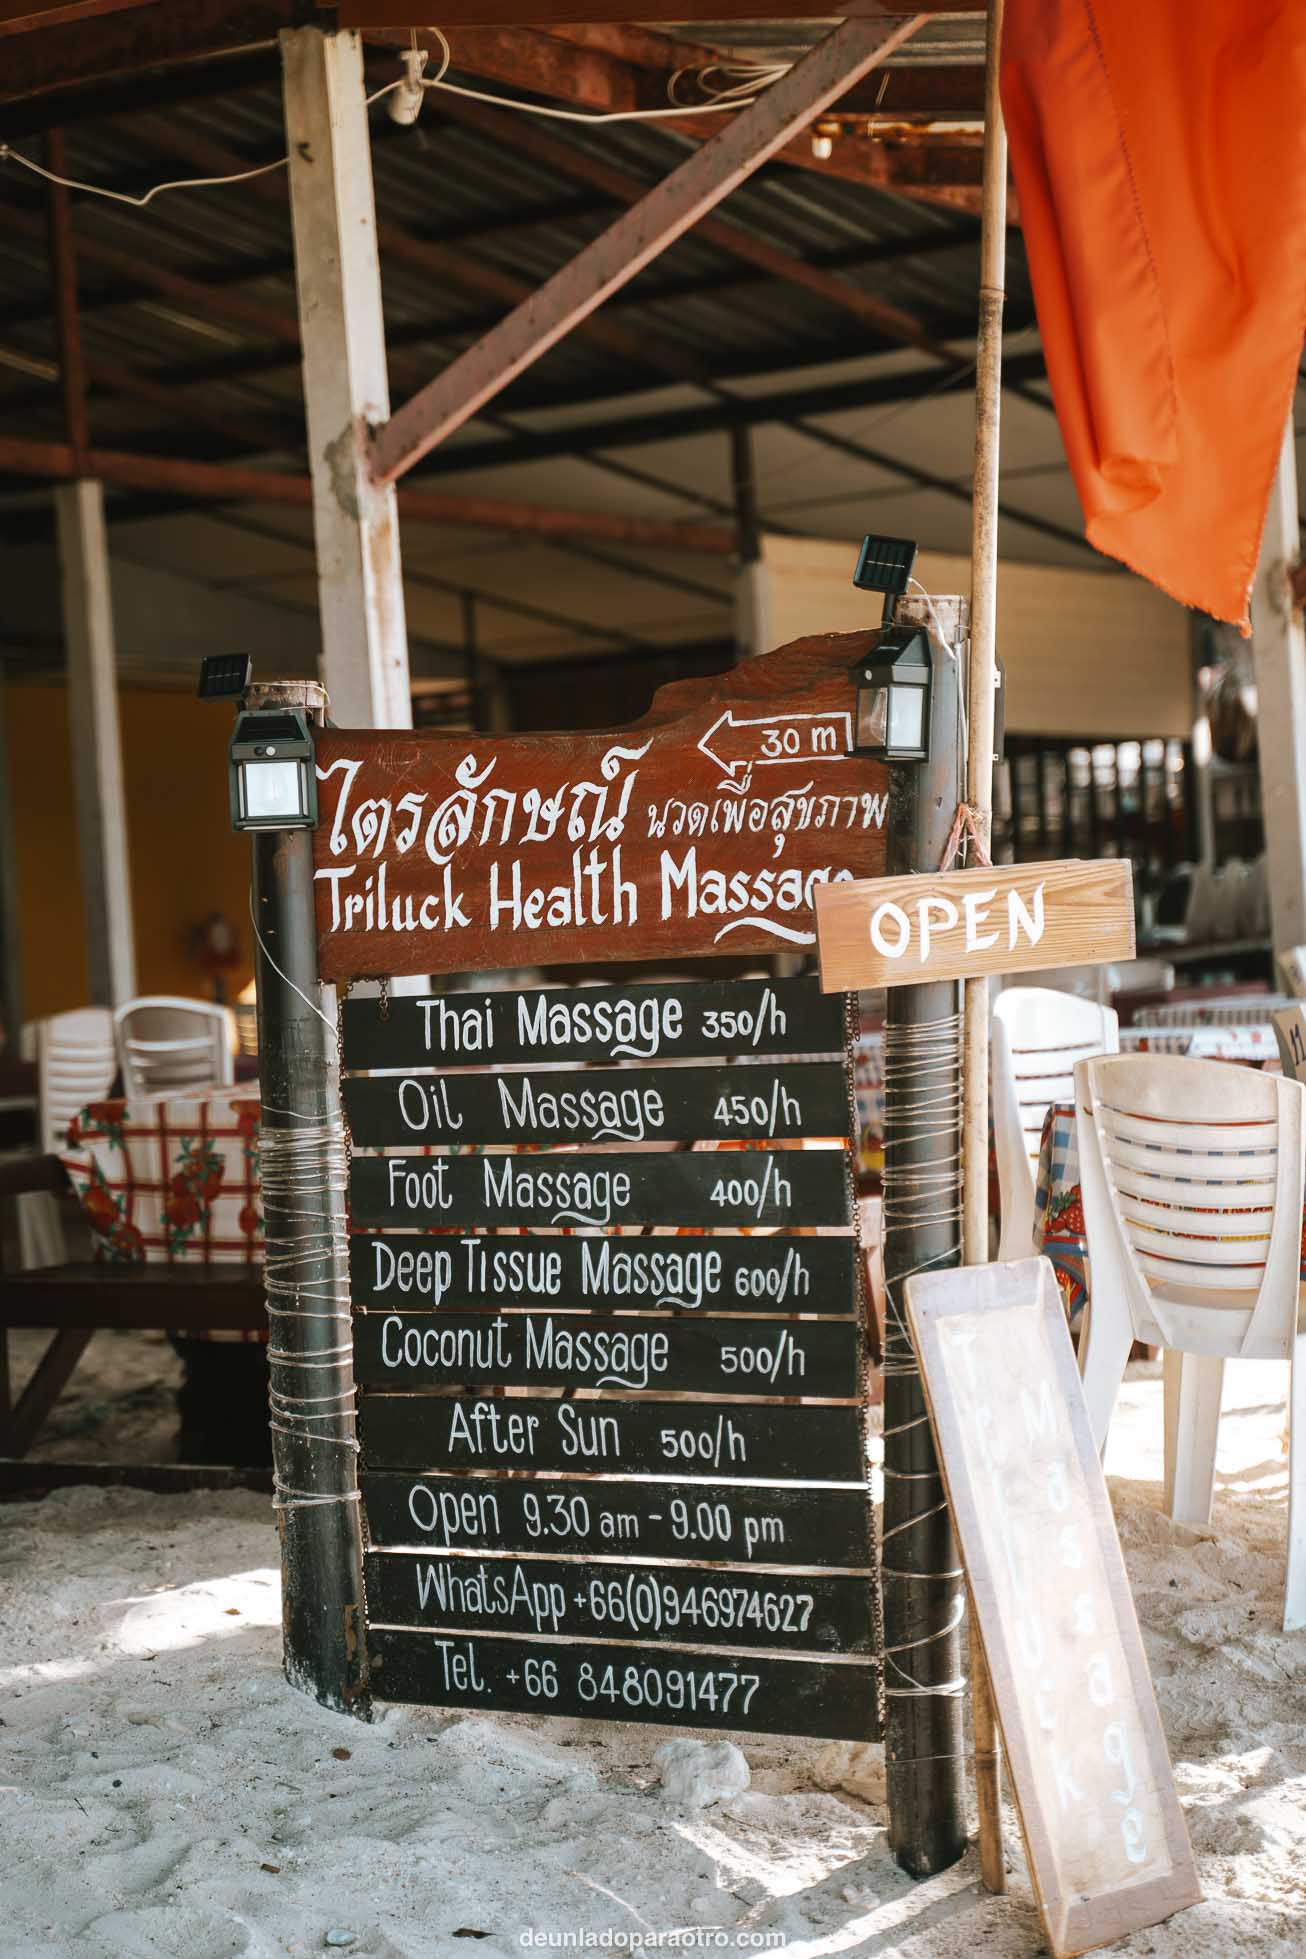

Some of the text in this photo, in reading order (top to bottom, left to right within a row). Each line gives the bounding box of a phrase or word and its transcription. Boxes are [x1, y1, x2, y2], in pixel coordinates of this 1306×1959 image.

[760, 726, 837, 758] 30 m
[646, 761, 888, 859] นวดเพื่อสุขภาพ
[312, 861, 473, 933] Triluck
[488, 844, 638, 932] Health
[870, 882, 1045, 963] OPEN
[415, 987, 787, 1058] Thai Massage 350/h
[398, 1077, 802, 1142] Oil Massage 450/h
[388, 1154, 792, 1226] Foot Massage 400/h
[371, 1238, 810, 1309] Deep Tissue Massage 600/h
[381, 1315, 805, 1389] Coconut Massage 500/h
[448, 1401, 746, 1468] After Sun 500/h
[408, 1484, 500, 1546] Open
[523, 1493, 590, 1537] 9.30
[599, 1511, 639, 1538] am
[670, 1499, 732, 1542] 9.00
[744, 1517, 785, 1559] pm
[415, 1563, 814, 1632] WhatsApp +66(0)946974627
[434, 1640, 760, 1715] Tel. +66 848091477
